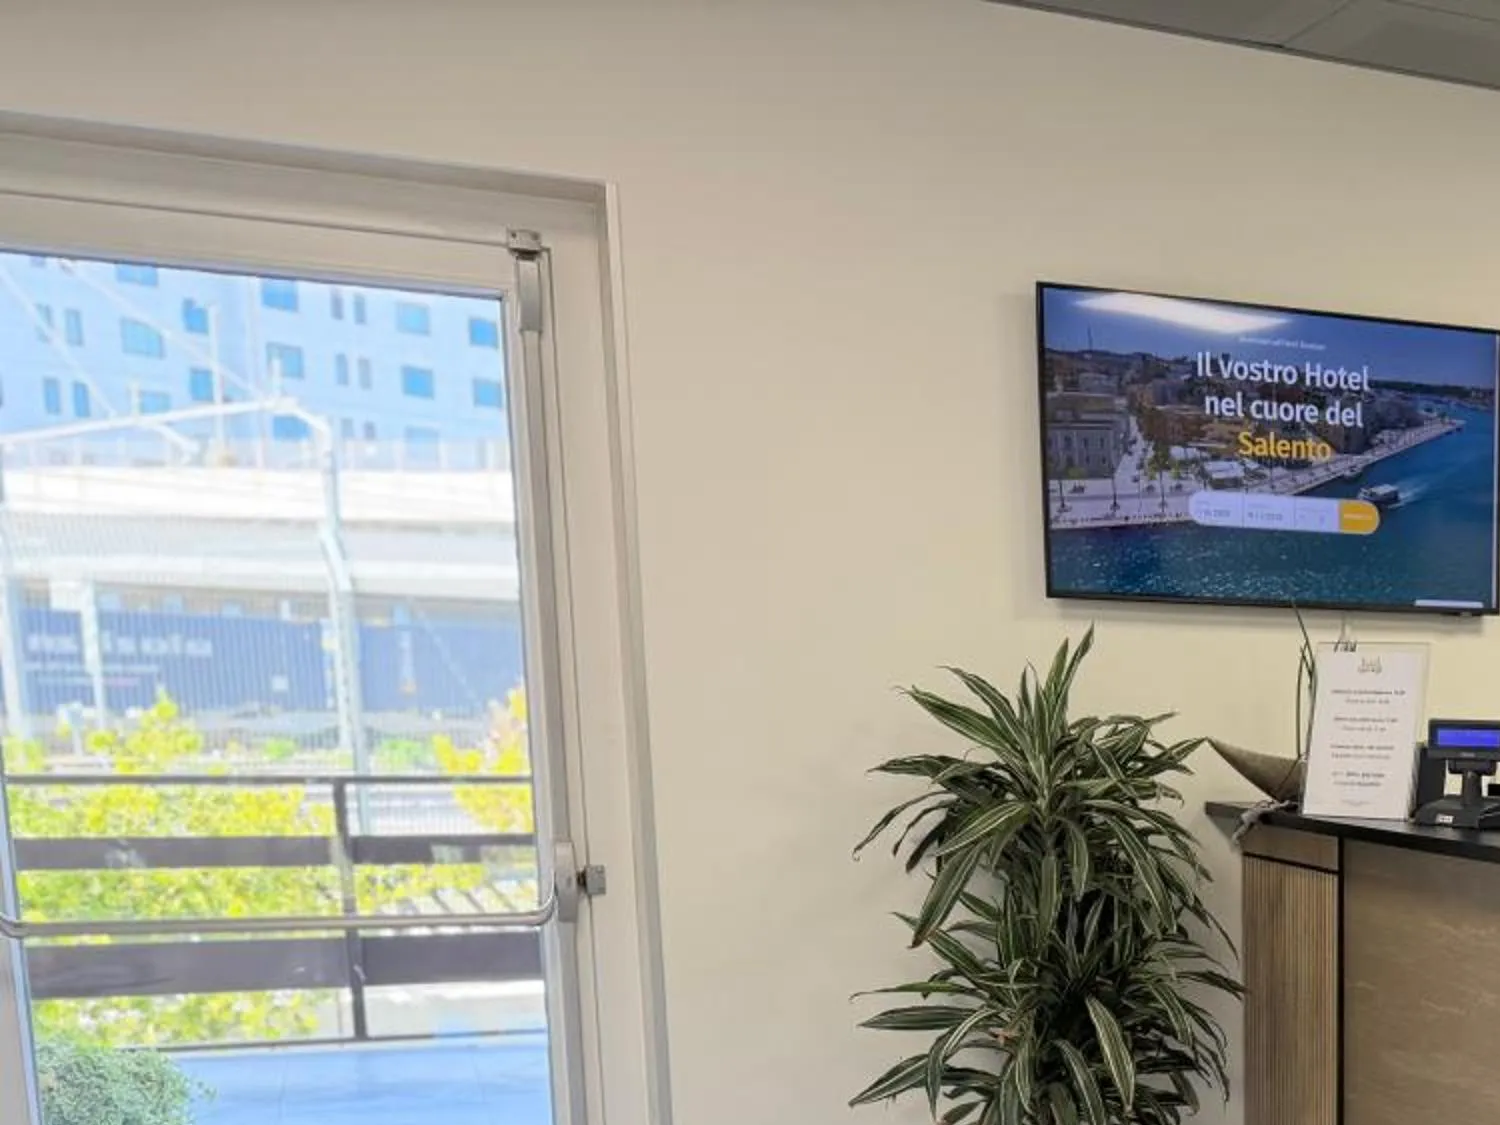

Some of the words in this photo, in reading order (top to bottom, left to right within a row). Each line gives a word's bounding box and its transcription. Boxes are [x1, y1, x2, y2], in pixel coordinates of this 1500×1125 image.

[1197, 351, 1213, 377] Il
[1305, 362, 1370, 392] Hotel
[1205, 391, 1244, 417] nel
[1250, 398, 1319, 423] cuore
[1325, 401, 1364, 428] del
[1238, 431, 1332, 462] Salento
